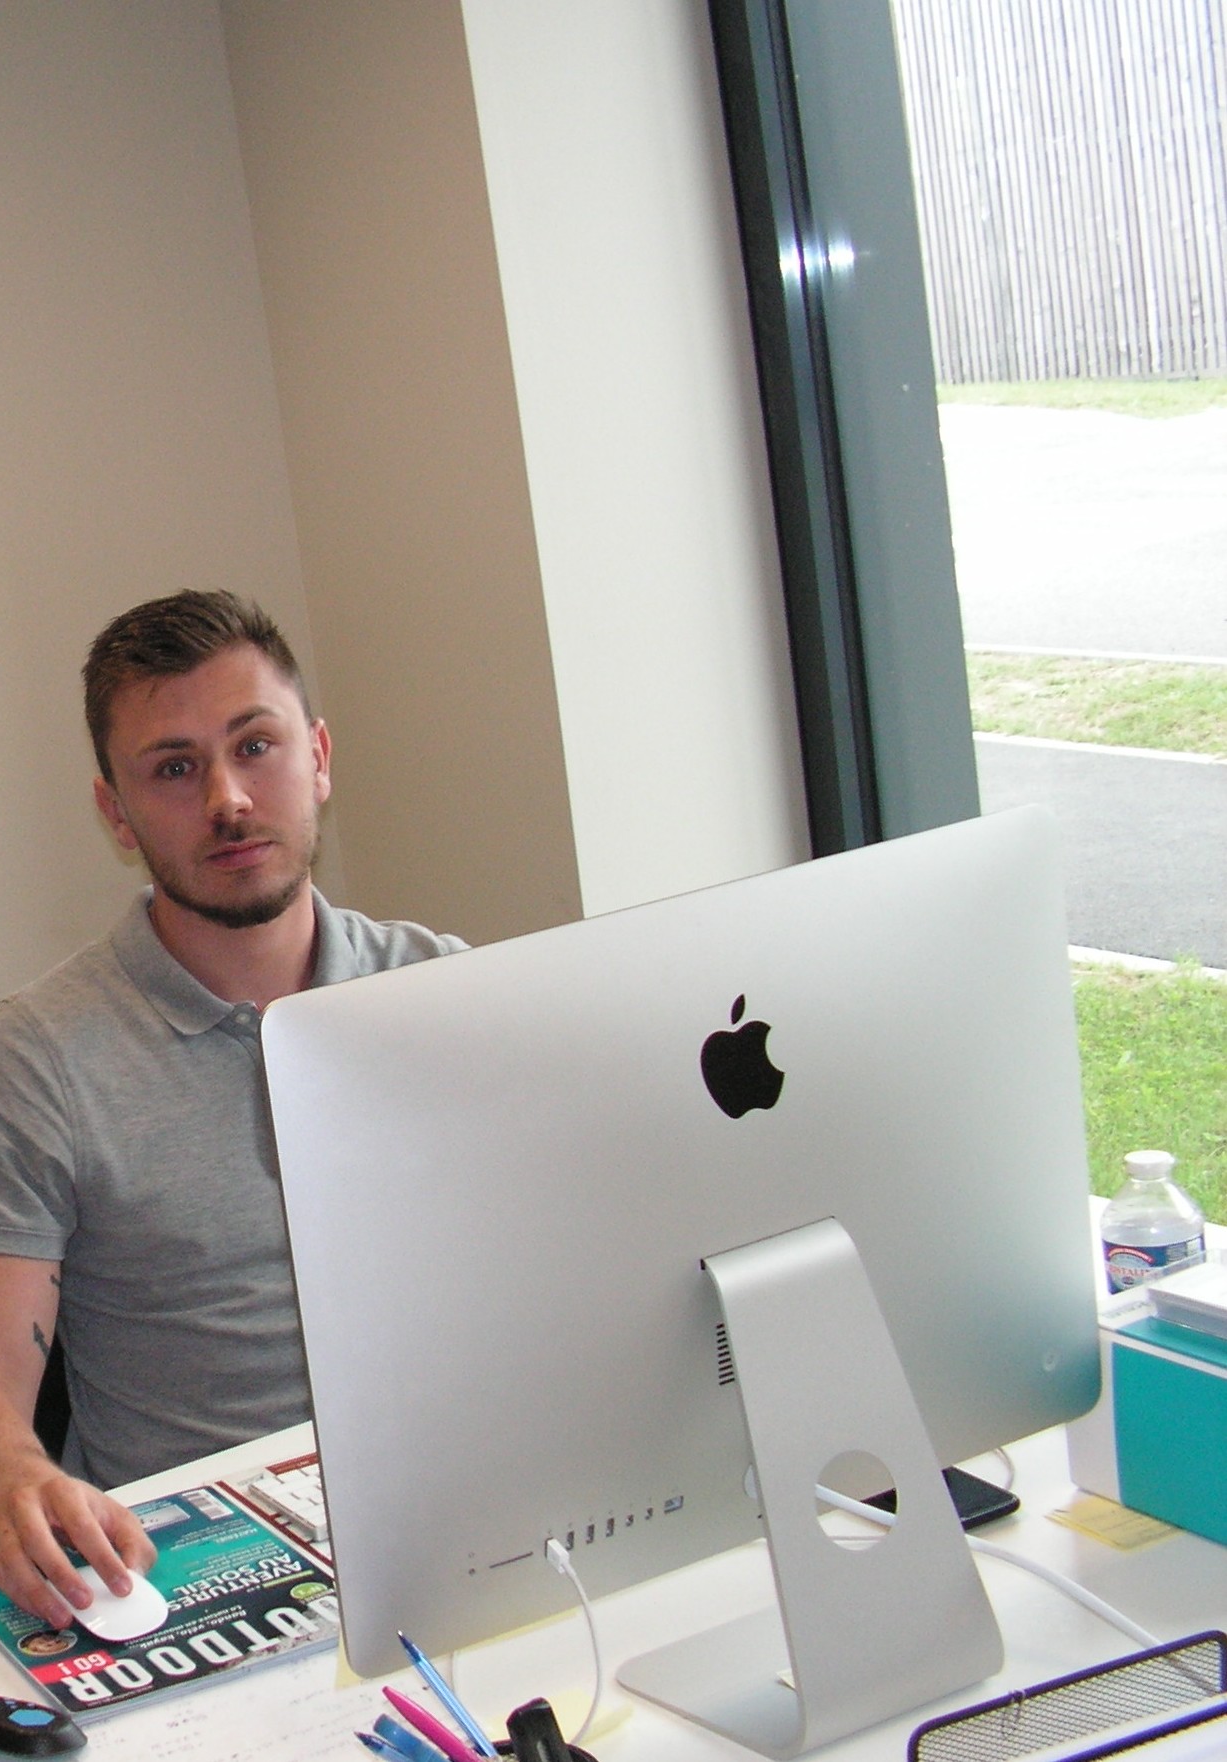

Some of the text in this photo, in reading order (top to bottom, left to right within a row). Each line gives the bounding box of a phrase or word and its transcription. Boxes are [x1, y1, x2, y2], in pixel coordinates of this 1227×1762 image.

[258, 1553, 291, 1570] AU
[167, 1561, 302, 1611] AVENTURES
[173, 1564, 254, 1595] SOLEIL
[61, 1595, 340, 1702] OUTDOOR
[74, 1653, 107, 1671] GO
